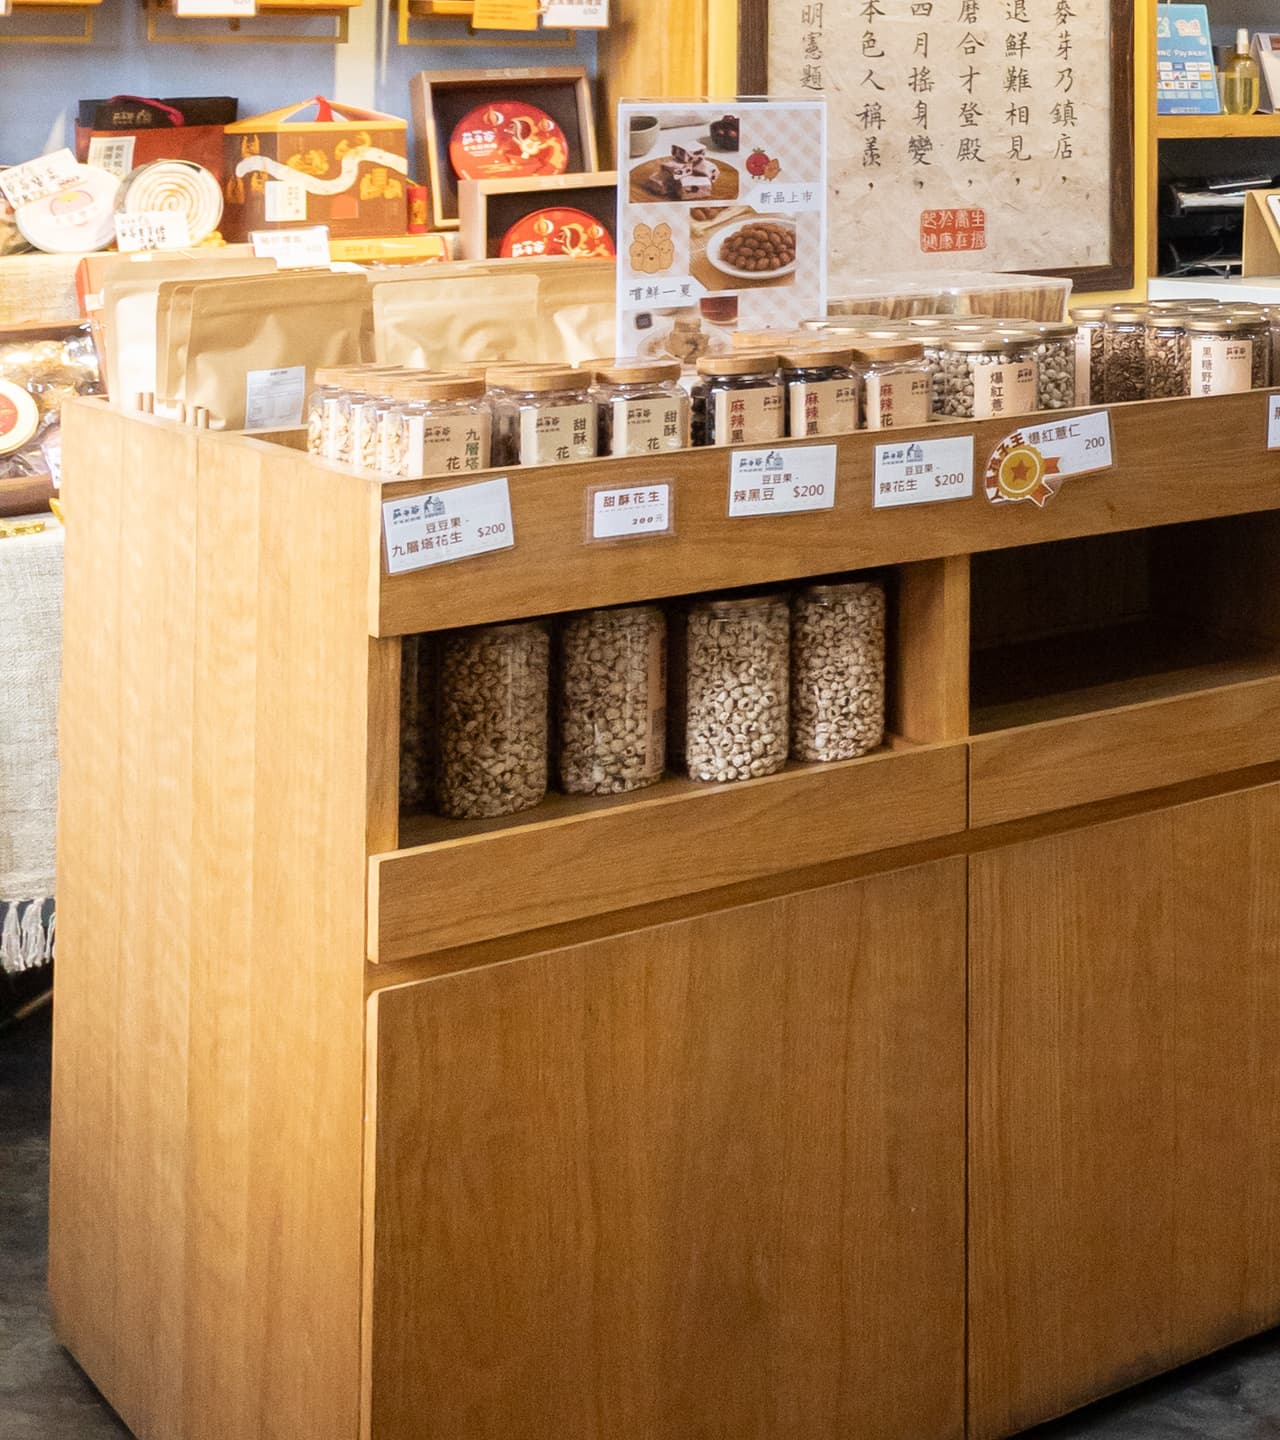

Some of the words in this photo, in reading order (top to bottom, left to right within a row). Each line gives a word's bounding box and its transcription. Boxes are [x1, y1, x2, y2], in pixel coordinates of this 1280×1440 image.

[759, 189, 814, 205] 新品上市
[628, 283, 693, 302] 嚐鮮一夏
[879, 384, 894, 427] 麻辣花
[573, 417, 587, 445] 甜酥
[664, 410, 678, 437] 甜酥
[1027, 422, 1082, 445] 爆紅薏仁
[464, 428, 481, 469] 九層塔
[556, 446, 570, 460] 花
[647, 437, 661, 451] 花
[1084, 436, 1106, 451] 200
[733, 487, 775, 504] 辣黑豆
[793, 484, 825, 499] $200
[879, 478, 919, 496] 辣花生
[934, 471, 965, 489] $200
[602, 490, 661, 508] 甜酥花生
[391, 530, 464, 557] 九層塔花生
[476, 522, 506, 539] $200
